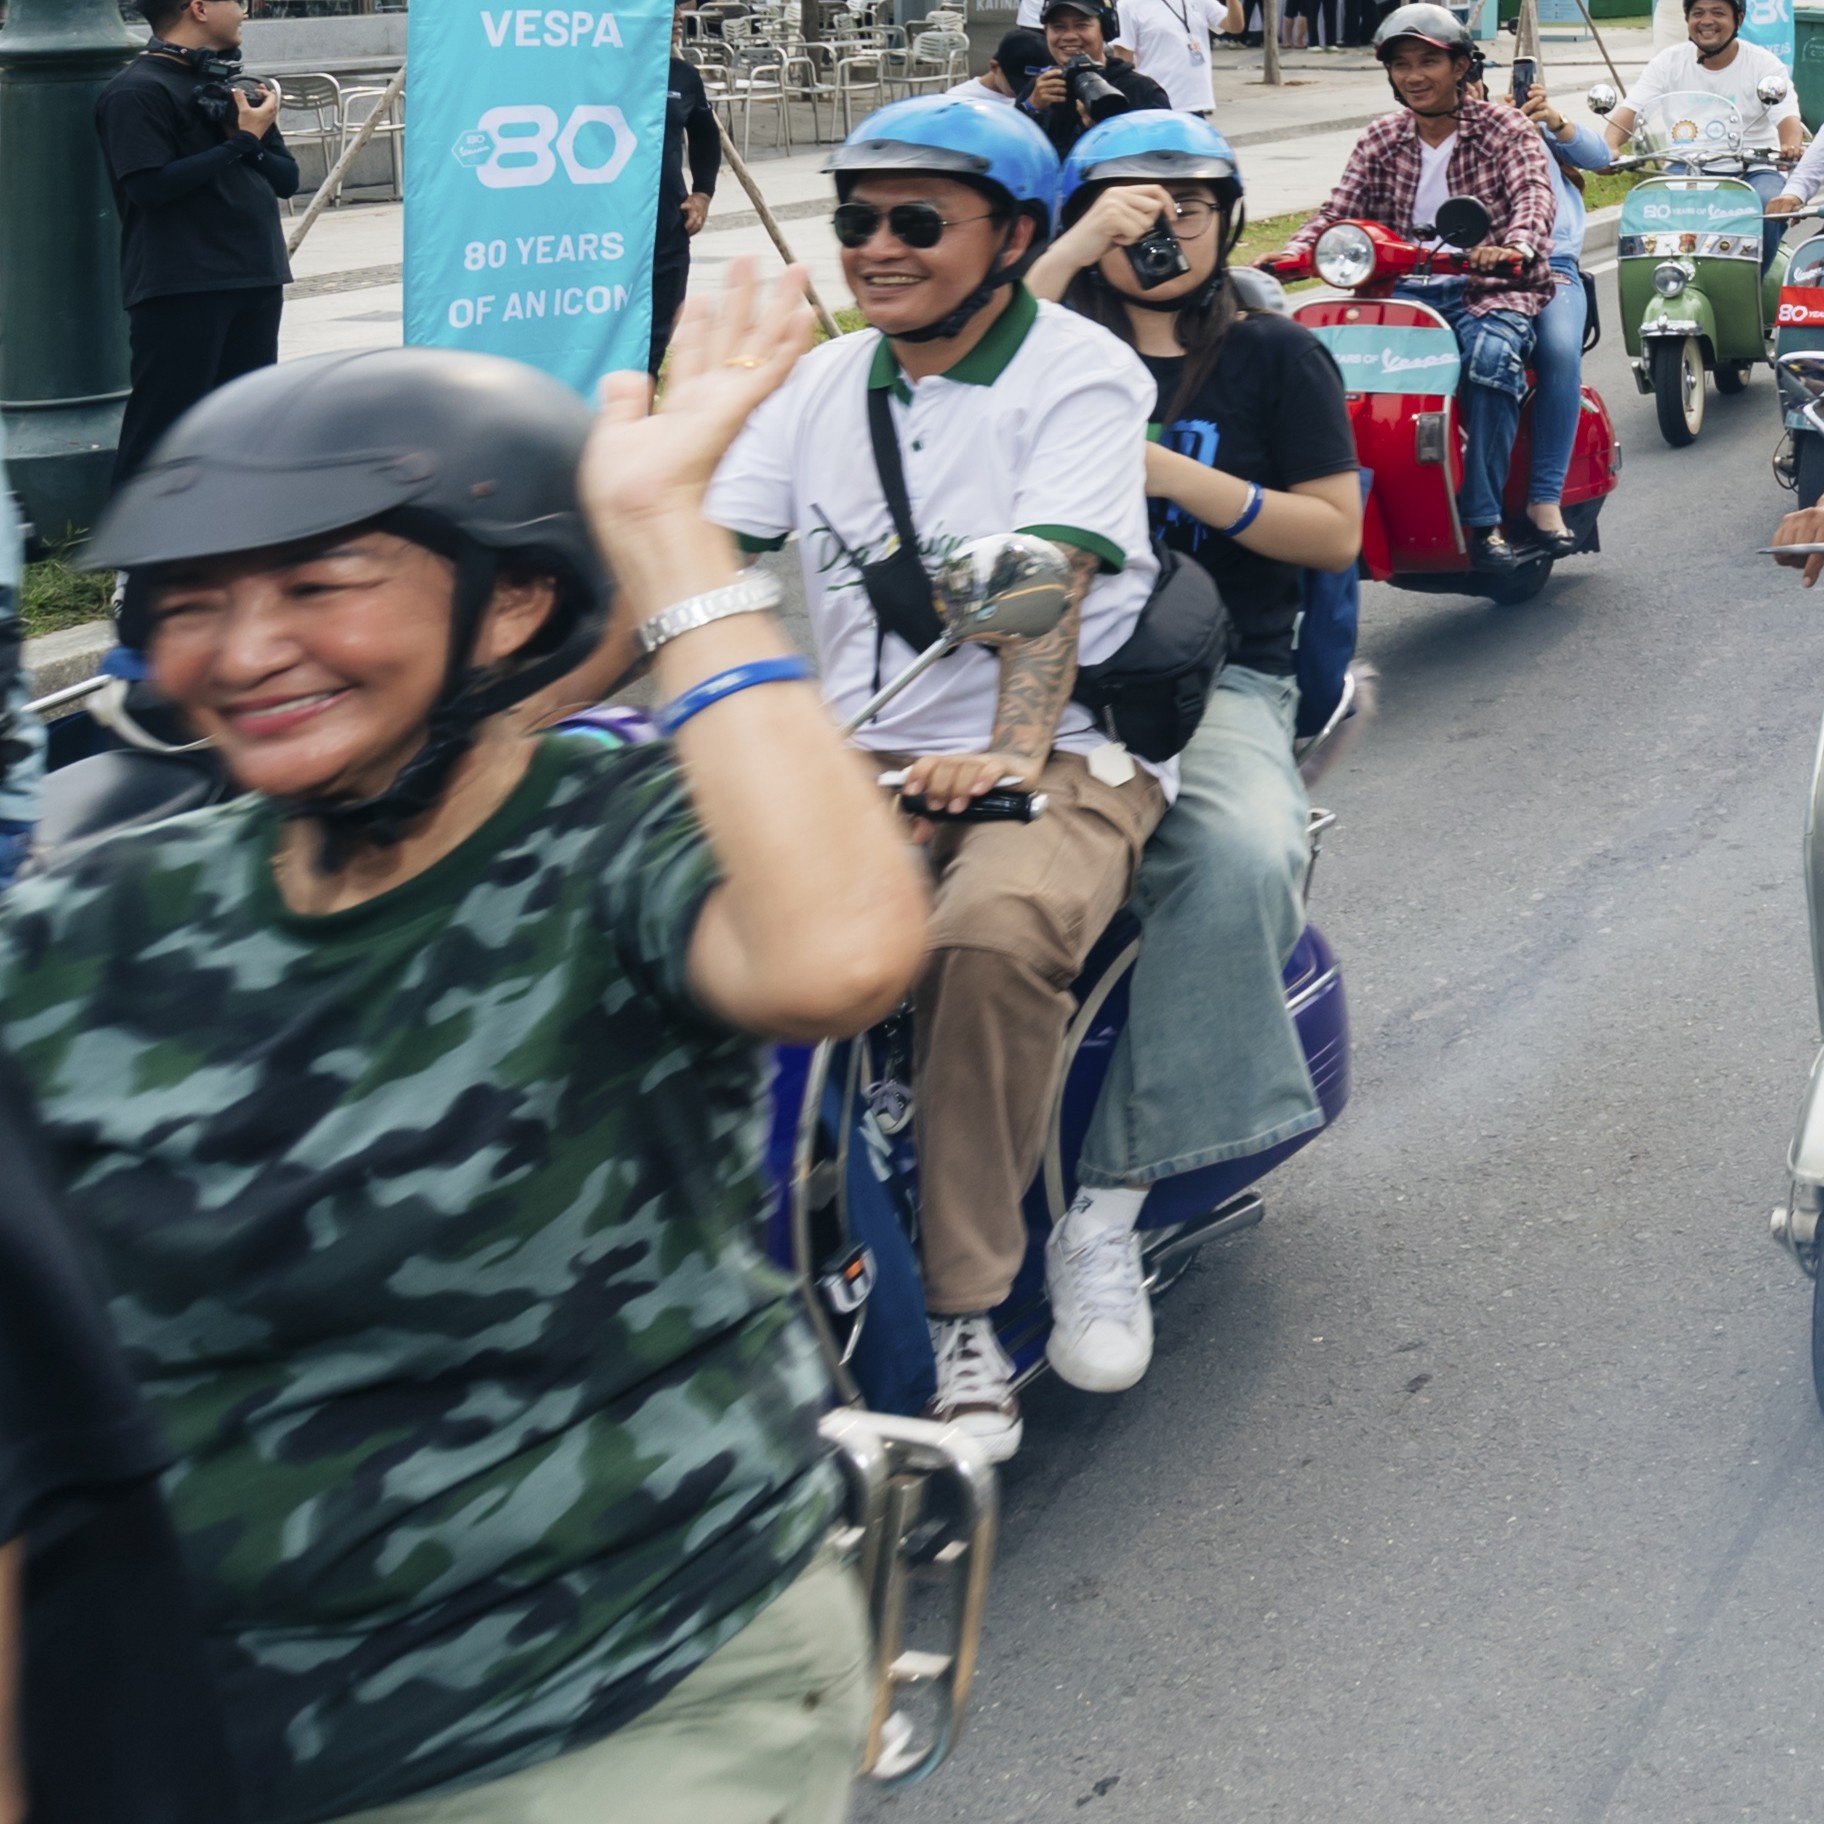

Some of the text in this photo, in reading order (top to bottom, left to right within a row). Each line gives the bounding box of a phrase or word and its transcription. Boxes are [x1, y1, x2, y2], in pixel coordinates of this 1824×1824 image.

[480, 10, 624, 48] VESPA
[476, 104, 638, 189] 80
[1643, 204, 1672, 219] 80
[1708, 203, 1758, 220] Vespa
[464, 232, 625, 271] 80 YEARS
[448, 284, 634, 329] OF AN ICON
[1779, 304, 1807, 321] 80
[1363, 354, 1379, 364] OF
[1381, 347, 1460, 374] Vespa
